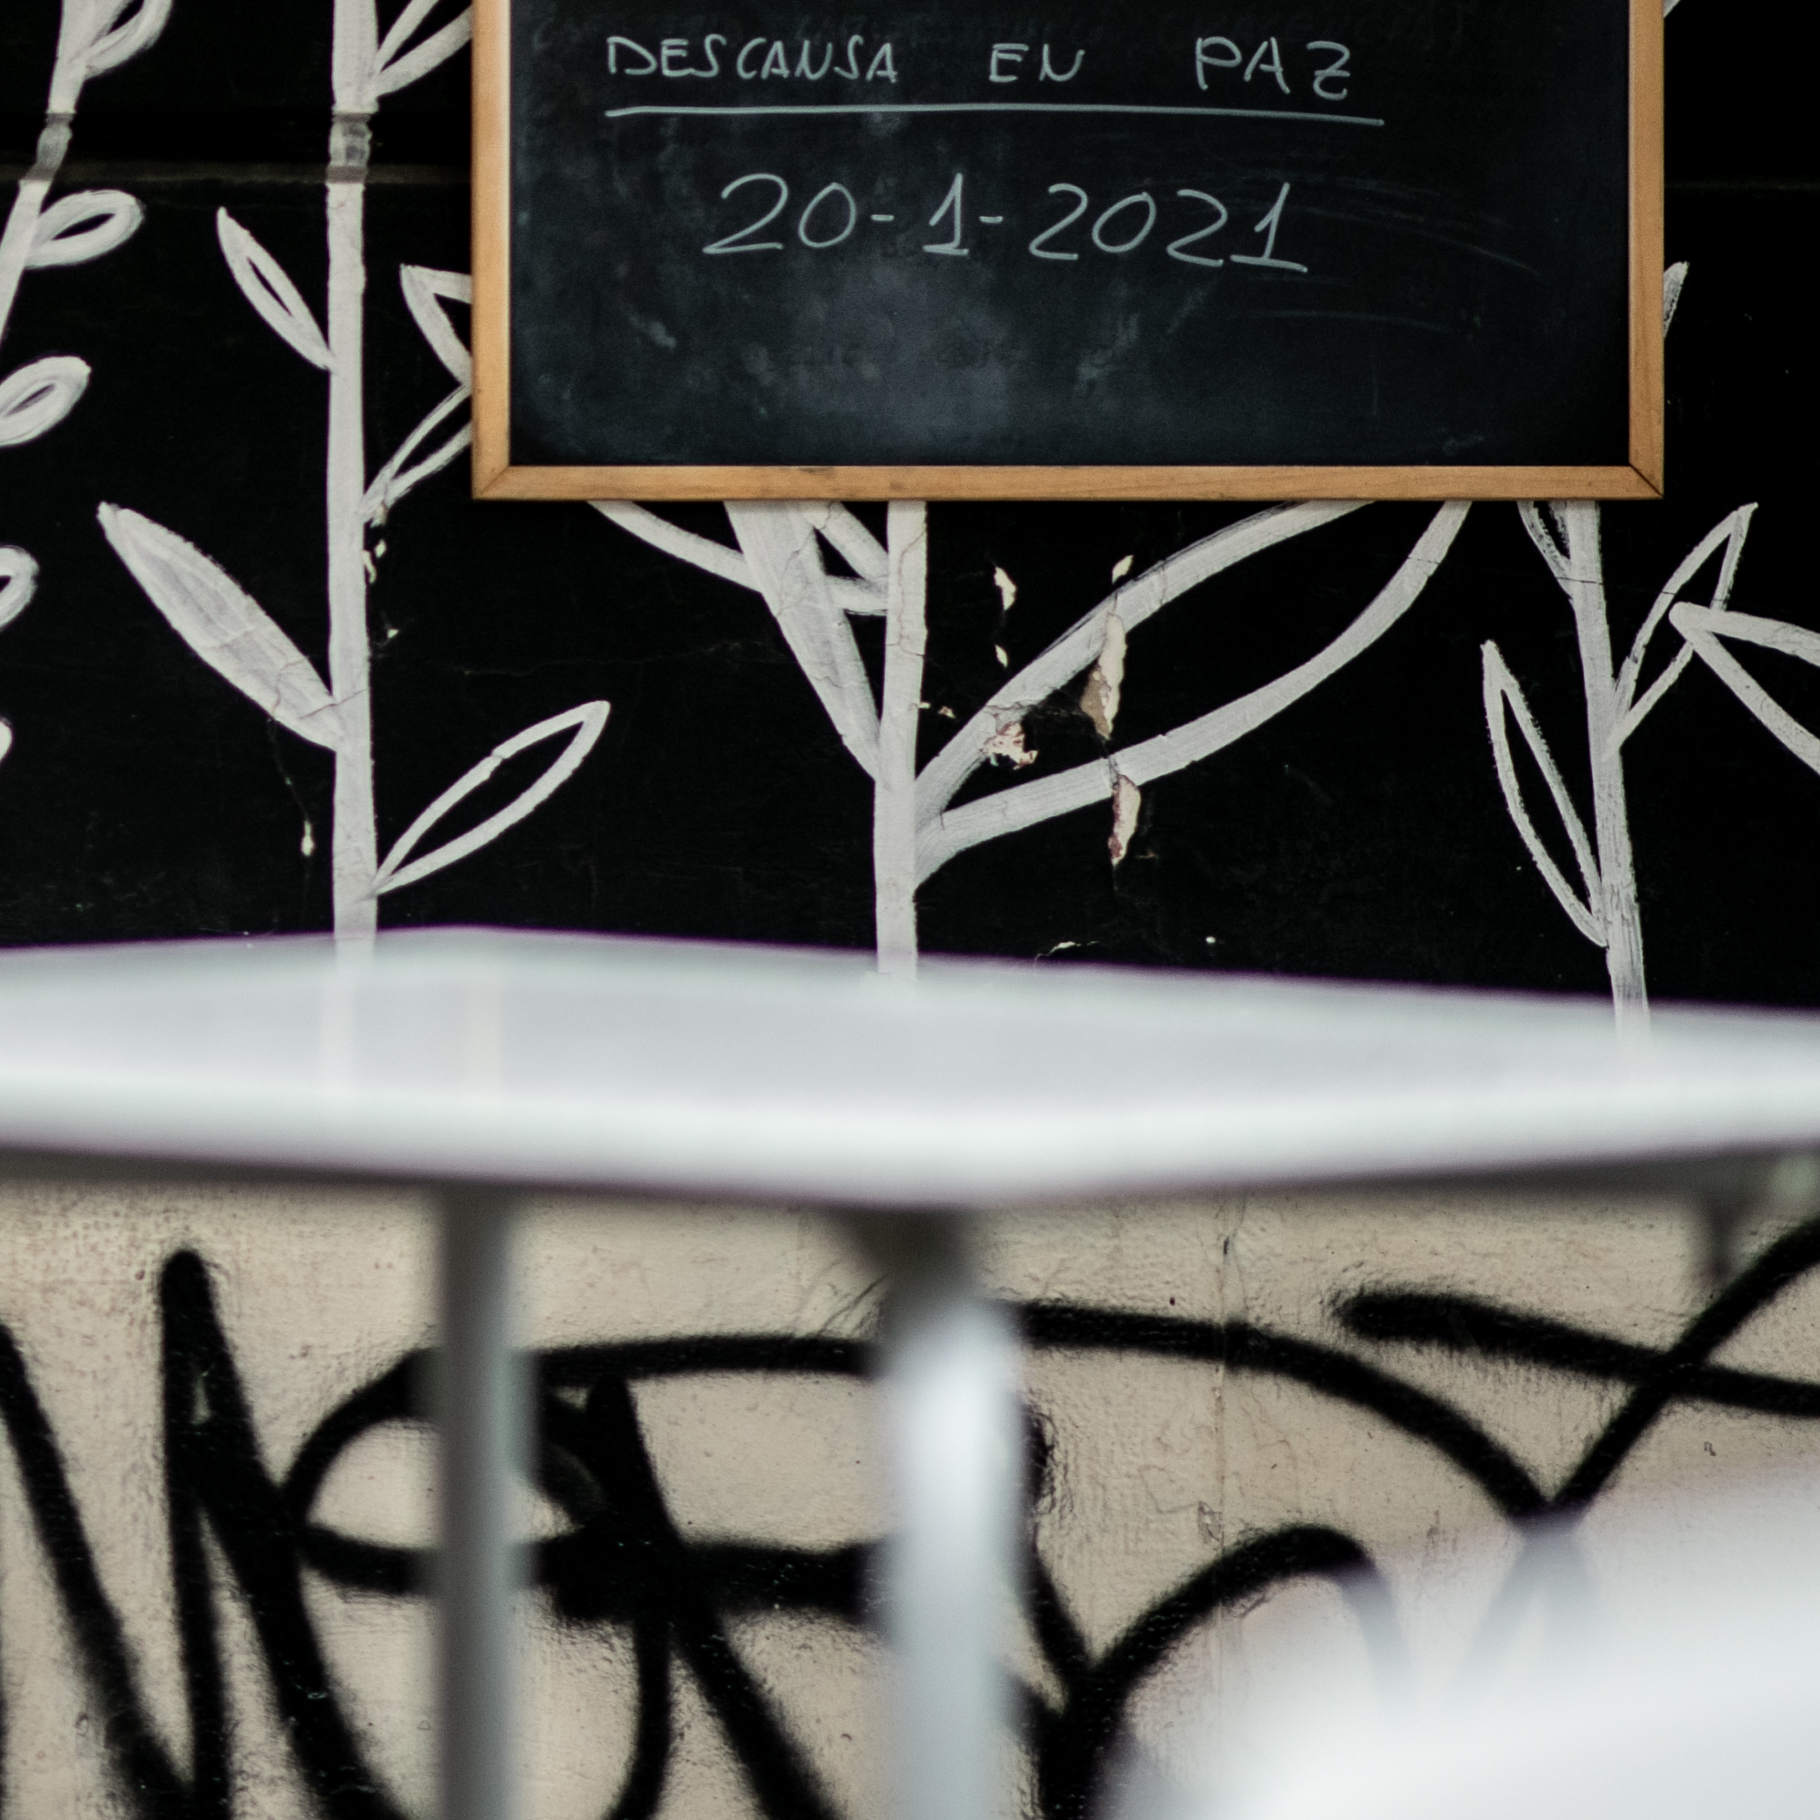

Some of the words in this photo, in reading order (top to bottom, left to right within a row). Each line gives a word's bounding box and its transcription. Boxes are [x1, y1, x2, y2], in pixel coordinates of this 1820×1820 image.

[605, 32, 900, 84] DESCANSA
[988, 42, 1086, 84] EN
[1194, 35, 1352, 100] PAZ
[701, 171, 1309, 274] 20-1-2021
